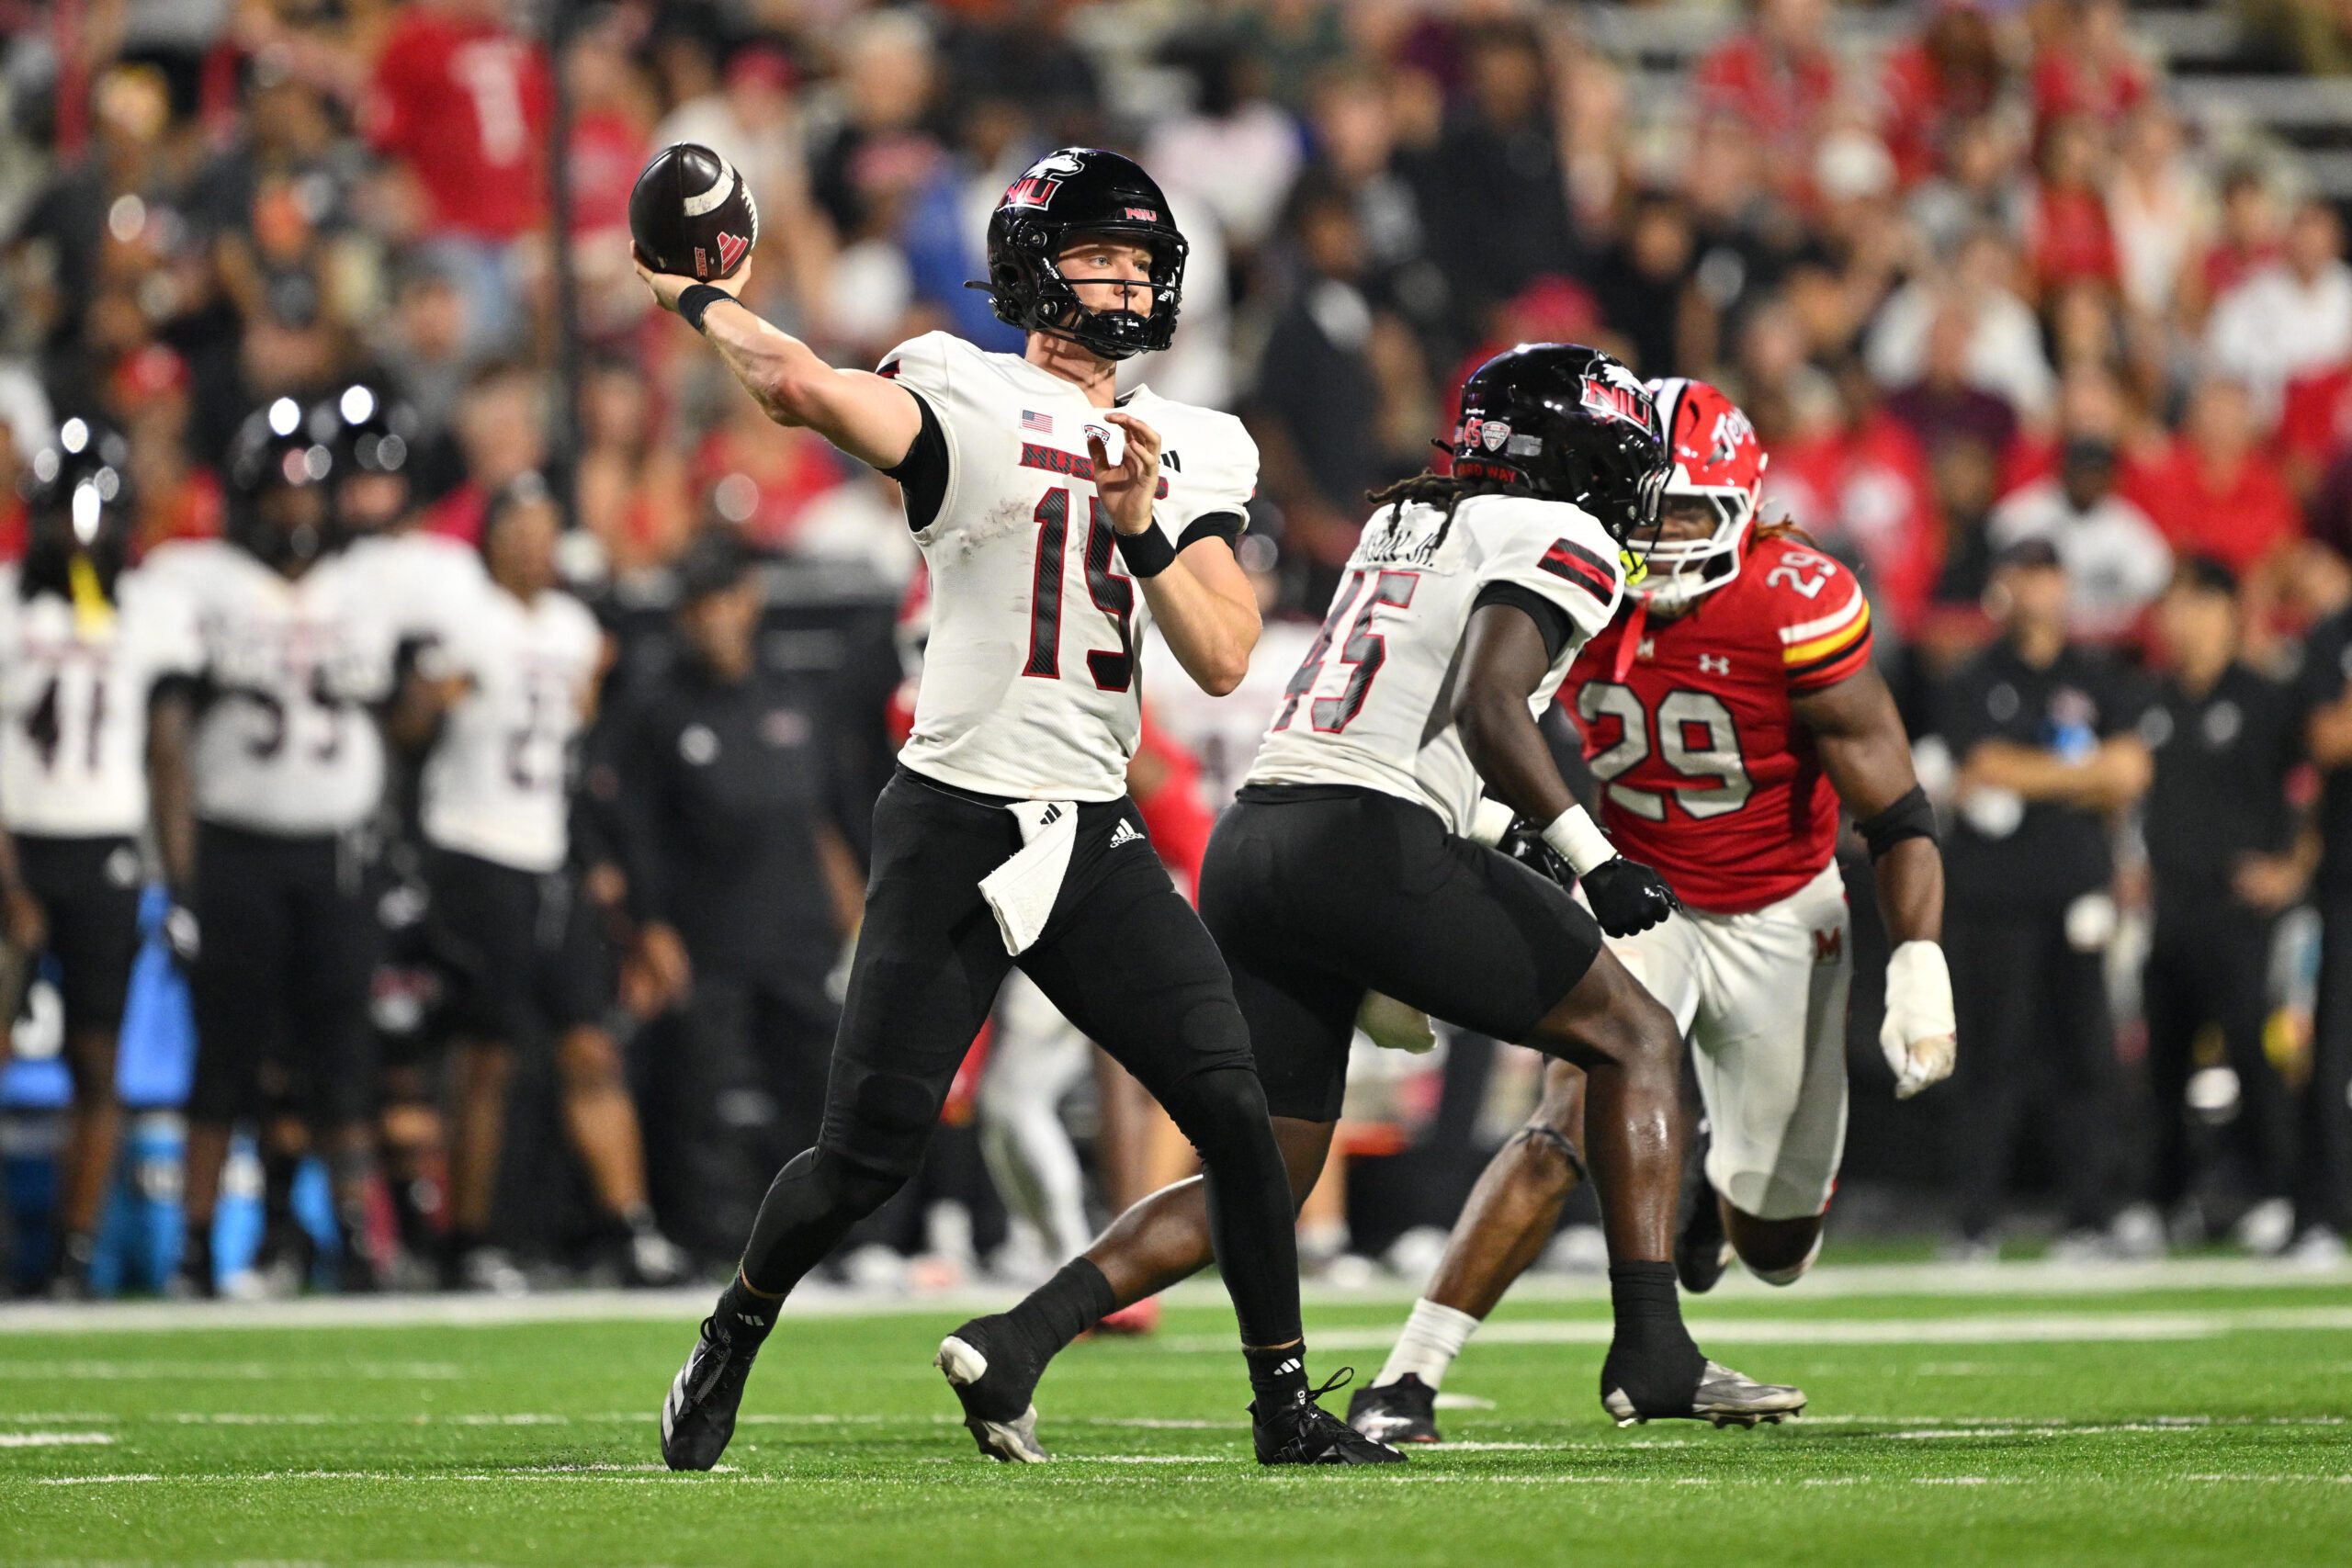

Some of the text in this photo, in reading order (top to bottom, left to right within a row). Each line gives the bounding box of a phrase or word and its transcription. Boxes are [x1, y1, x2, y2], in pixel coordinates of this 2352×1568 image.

[998, 177, 1057, 208] NIU
[1124, 207, 1158, 222] NIU
[1585, 378, 1651, 428] NIU
[1464, 418, 1484, 449] 45
[1487, 465, 1515, 484] WAY
[1022, 486, 1135, 694] 15
[1766, 551, 1838, 600] 29
[1272, 569, 1420, 734] 45
[1577, 680, 1754, 821] 29
[1815, 926, 1842, 963] M
